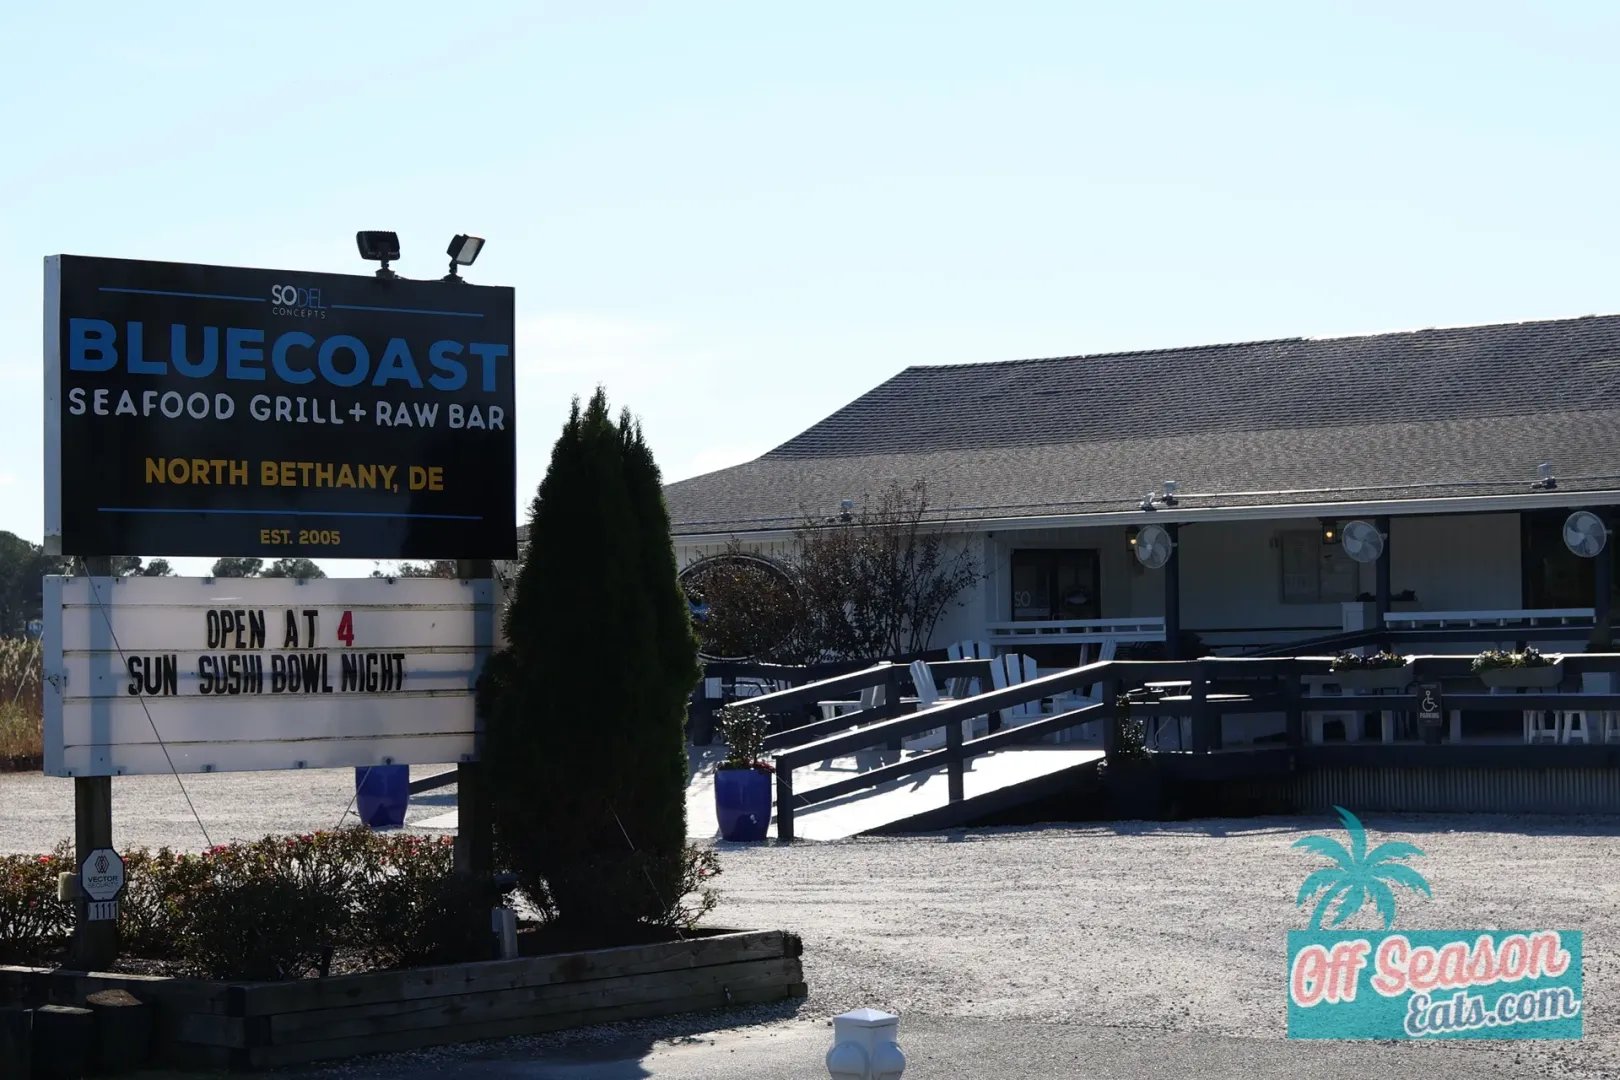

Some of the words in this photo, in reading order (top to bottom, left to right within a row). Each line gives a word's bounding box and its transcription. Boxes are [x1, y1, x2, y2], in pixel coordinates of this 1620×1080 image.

[272, 284, 327, 309] SODEL
[69, 318, 509, 393] BLUECOAST
[69, 387, 236, 421] SEAFOOD
[376, 400, 439, 429] RAW
[448, 403, 505, 431] BAR
[145, 457, 249, 486] NORTH
[260, 461, 399, 494] BETHANY,
[409, 466, 445, 491] DE
[260, 529, 293, 545] EST.
[299, 529, 341, 546] 2005
[207, 609, 265, 649] OPEN
[283, 609, 319, 648] AT
[336, 610, 355, 646] 4
[127, 654, 178, 696] SUN
[198, 654, 263, 694] SUSHI
[271, 653, 334, 694] BOWL
[340, 652, 405, 692] NIGHT
